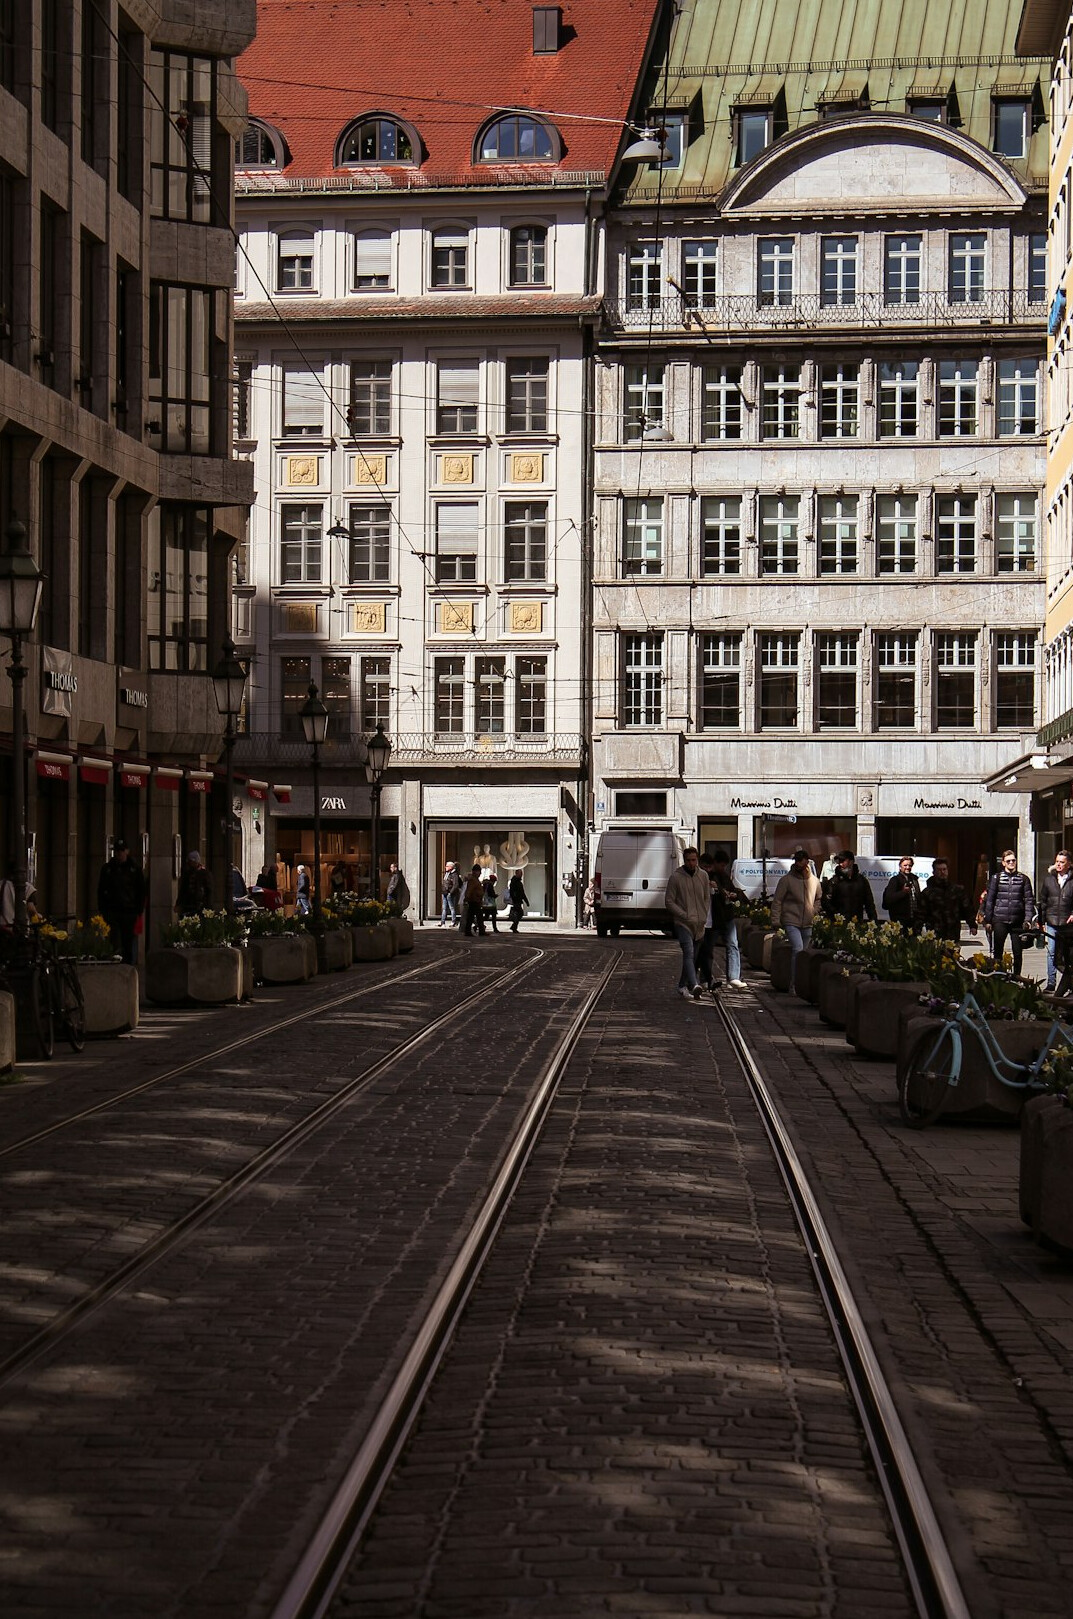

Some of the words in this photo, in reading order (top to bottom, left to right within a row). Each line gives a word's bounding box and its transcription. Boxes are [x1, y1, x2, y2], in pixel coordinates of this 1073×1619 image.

[51, 671, 78, 693] THOMAS
[126, 688, 148, 708] THOMAS
[321, 797, 346, 810] ZARA
[730, 797, 771, 809] Massimo
[773, 797, 798, 809] Dutti
[913, 798, 954, 809] Massimo
[957, 798, 982, 809] Dutti
